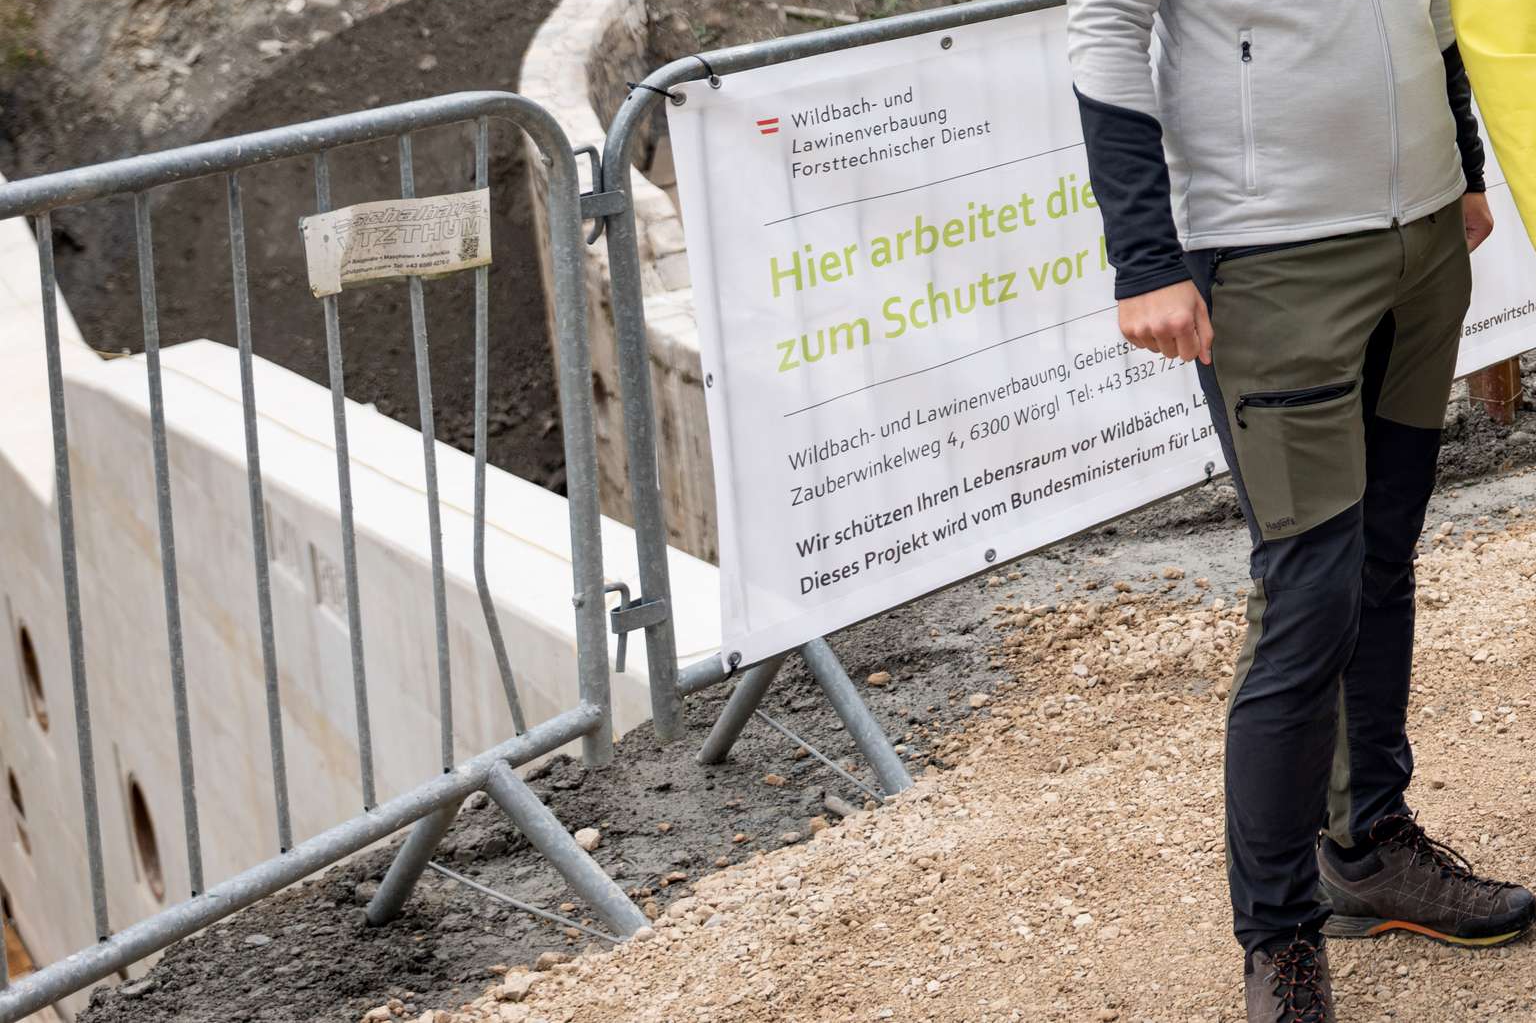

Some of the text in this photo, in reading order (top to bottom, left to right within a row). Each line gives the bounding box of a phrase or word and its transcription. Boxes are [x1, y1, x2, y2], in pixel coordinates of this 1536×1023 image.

[791, 87, 912, 129] Wildbach- und
[792, 108, 947, 154] Lawinenverbauung
[792, 120, 991, 179] Forsttechnischer Dienst
[770, 174, 1098, 298] Hier arbeitet die
[776, 317, 870, 372] zum
[882, 271, 1018, 339] Schutz
[1028, 249, 1088, 291] vor
[788, 429, 876, 471] Wildbach-
[880, 413, 911, 438] und
[916, 366, 1070, 426] Lawinenverbauung,
[790, 360, 1156, 507] Zauberwinkelweg 4, 6300 Wörgl Tel: +43 5332
[795, 403, 1189, 558] Wir schützen Ihren Lebensraum vor Wildbächen,
[800, 561, 860, 594] Dieses
[864, 531, 929, 570] Projekt
[932, 512, 968, 542] wird
[971, 501, 1007, 525] vom
[1010, 443, 1165, 510] Bundesministerium
[1168, 432, 1188, 451] für
